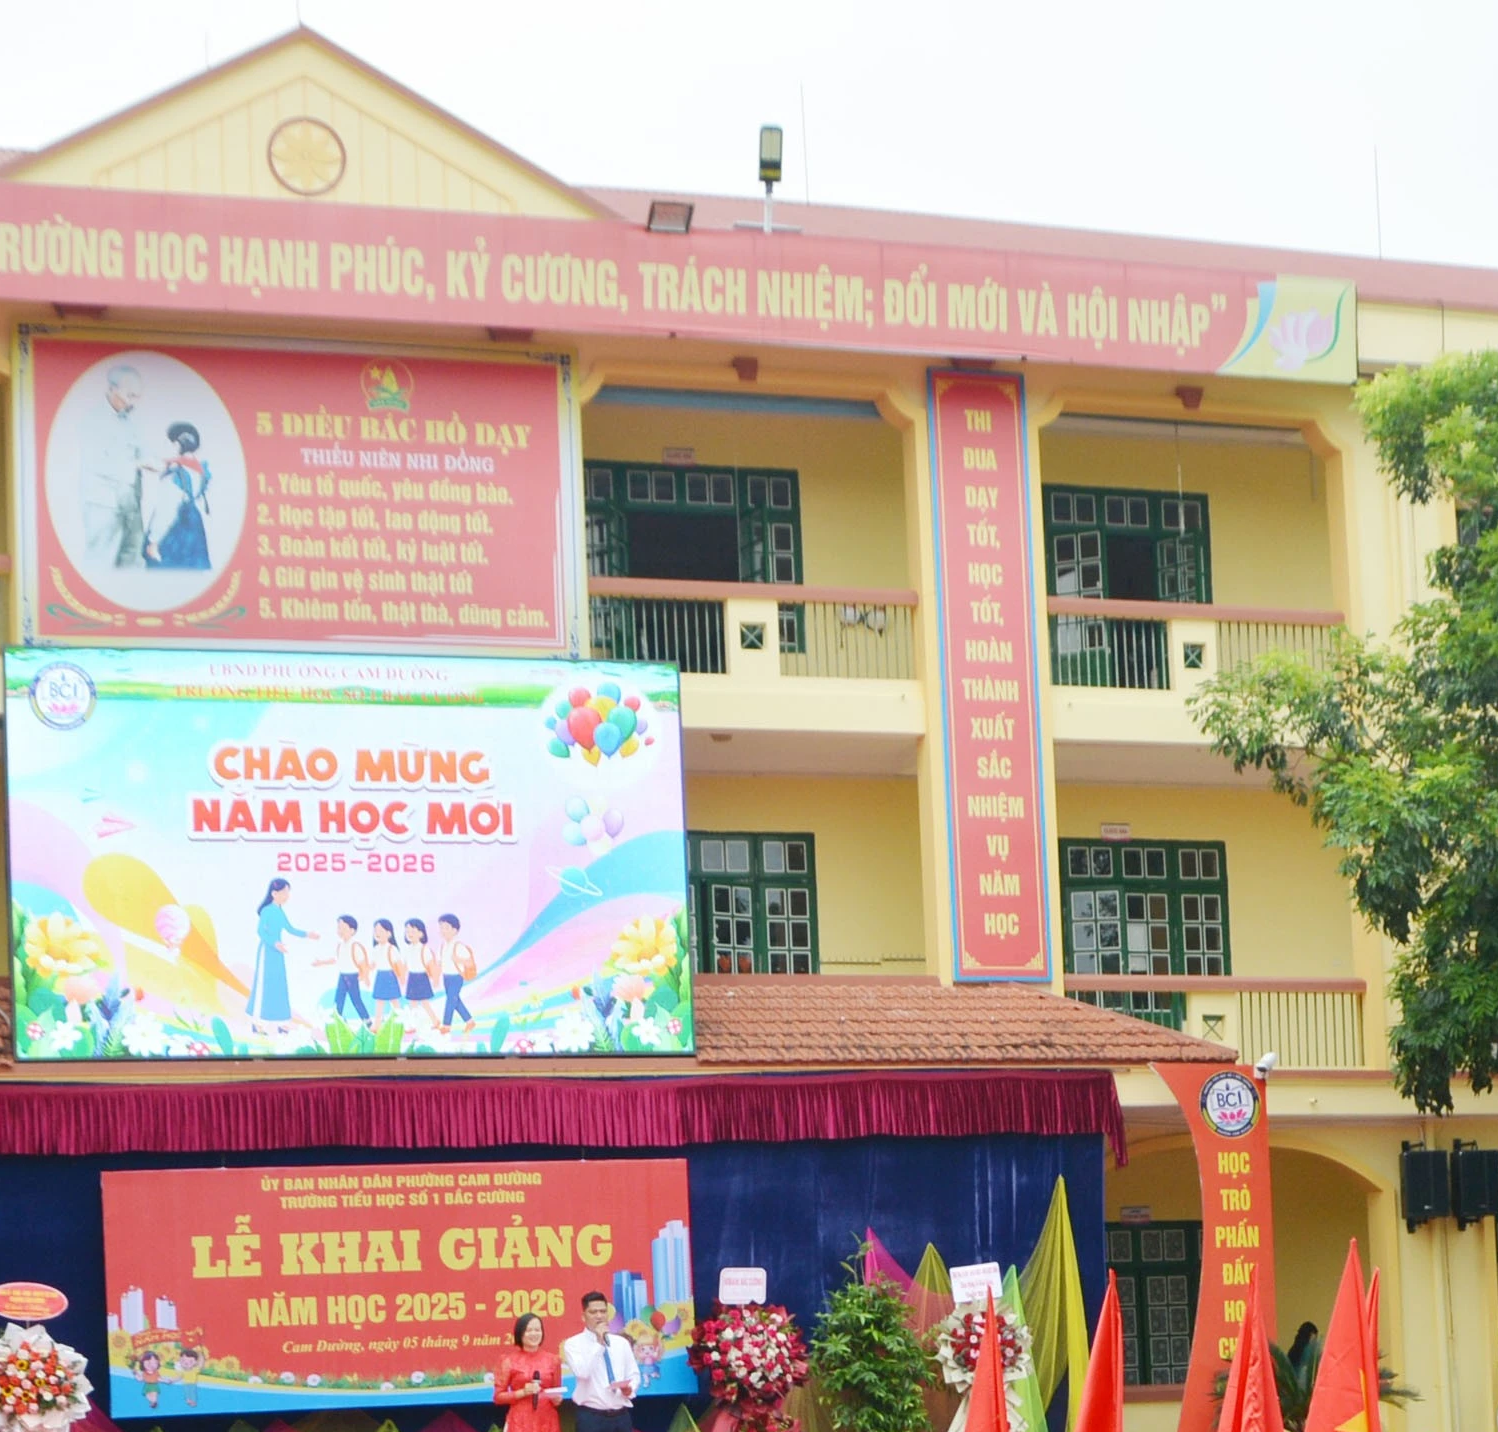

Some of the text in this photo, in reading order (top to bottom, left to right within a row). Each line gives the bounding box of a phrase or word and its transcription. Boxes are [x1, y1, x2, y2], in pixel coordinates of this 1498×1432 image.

[135, 231, 209, 293] HỌC
[220, 235, 319, 297] HẠNH
[330, 236, 435, 302] PHÚC,
[446, 236, 490, 300] KỶ
[502, 251, 628, 313] CƯƠNG,
[639, 256, 746, 315] TRÁCH
[756, 263, 874, 331] NHIỆM;
[884, 263, 937, 329] ĐỔI
[948, 277, 1008, 334] MỚI
[1017, 281, 1059, 337] VÀ
[1067, 286, 1118, 350] HỘI
[256, 411, 274, 436] 5
[425, 411, 467, 445] HỒ
[475, 422, 532, 456] DẠY
[965, 409, 991, 432] THI
[359, 448, 401, 470] NIÊN
[406, 451, 439, 471] NHI
[444, 448, 495, 474] ĐỒNG
[964, 447, 997, 470] ĐUA
[257, 473, 274, 494] 1.
[278, 473, 312, 495] Yêu
[392, 478, 424, 502] yêu
[965, 486, 998, 511] DẠY
[257, 504, 274, 526] 2.
[279, 504, 313, 530] Học
[319, 507, 347, 533] tập
[386, 509, 413, 530] lao
[257, 535, 275, 557] 3.
[279, 535, 325, 559] Đoàn
[967, 517, 1000, 549] TỐT,
[368, 570, 406, 592] sinh
[411, 571, 445, 597] thật
[968, 562, 1003, 589] HỌC
[259, 597, 276, 620] 5.
[281, 598, 339, 622] Khiêm
[381, 600, 416, 628] thật
[971, 595, 1004, 626] TỐT,
[965, 637, 1013, 662] HOÀN
[962, 673, 1019, 702] THÀNH
[971, 712, 1014, 740] XUẤT
[214, 740, 338, 781] CHÀO
[193, 792, 303, 833] NĂM
[319, 801, 410, 842] HỌC
[967, 792, 1024, 822] NHIỆM
[986, 834, 1009, 862] VỤ
[277, 852, 435, 873] 2025-2026
[979, 870, 1020, 896] NĂM
[984, 912, 1019, 939] HỌC
[1218, 1151, 1250, 1179] HỌC
[261, 1170, 542, 1191] ỦY BAN NHÂN DÂN PHƯỜNG CAM ĐƯỜNG
[280, 1193, 338, 1209] TRƯỜNG
[341, 1189, 372, 1208] TIỂU
[376, 1193, 405, 1210] HỌC
[409, 1189, 429, 1206] SỐ
[433, 1193, 440, 1206] 1
[477, 1188, 525, 1204] CƯỜNG
[1220, 1184, 1251, 1211] TRÒ
[191, 1214, 612, 1279] LỄ KHAI GIẢNG
[1215, 1218, 1260, 1248] PHẤN
[248, 1291, 318, 1327] NĂM
[326, 1294, 387, 1330] HỌC
[395, 1292, 466, 1322] 2025
[495, 1289, 565, 1318] 2026
[1224, 1300, 1247, 1327] HỌ
[282, 1341, 313, 1354] Cam
[316, 1339, 365, 1353] Đường,
[368, 1338, 399, 1353] ngày
[403, 1337, 418, 1349] 05
[421, 1335, 459, 1350] tháng
[462, 1335, 470, 1347] 9
[473, 1335, 502, 1347] năm
